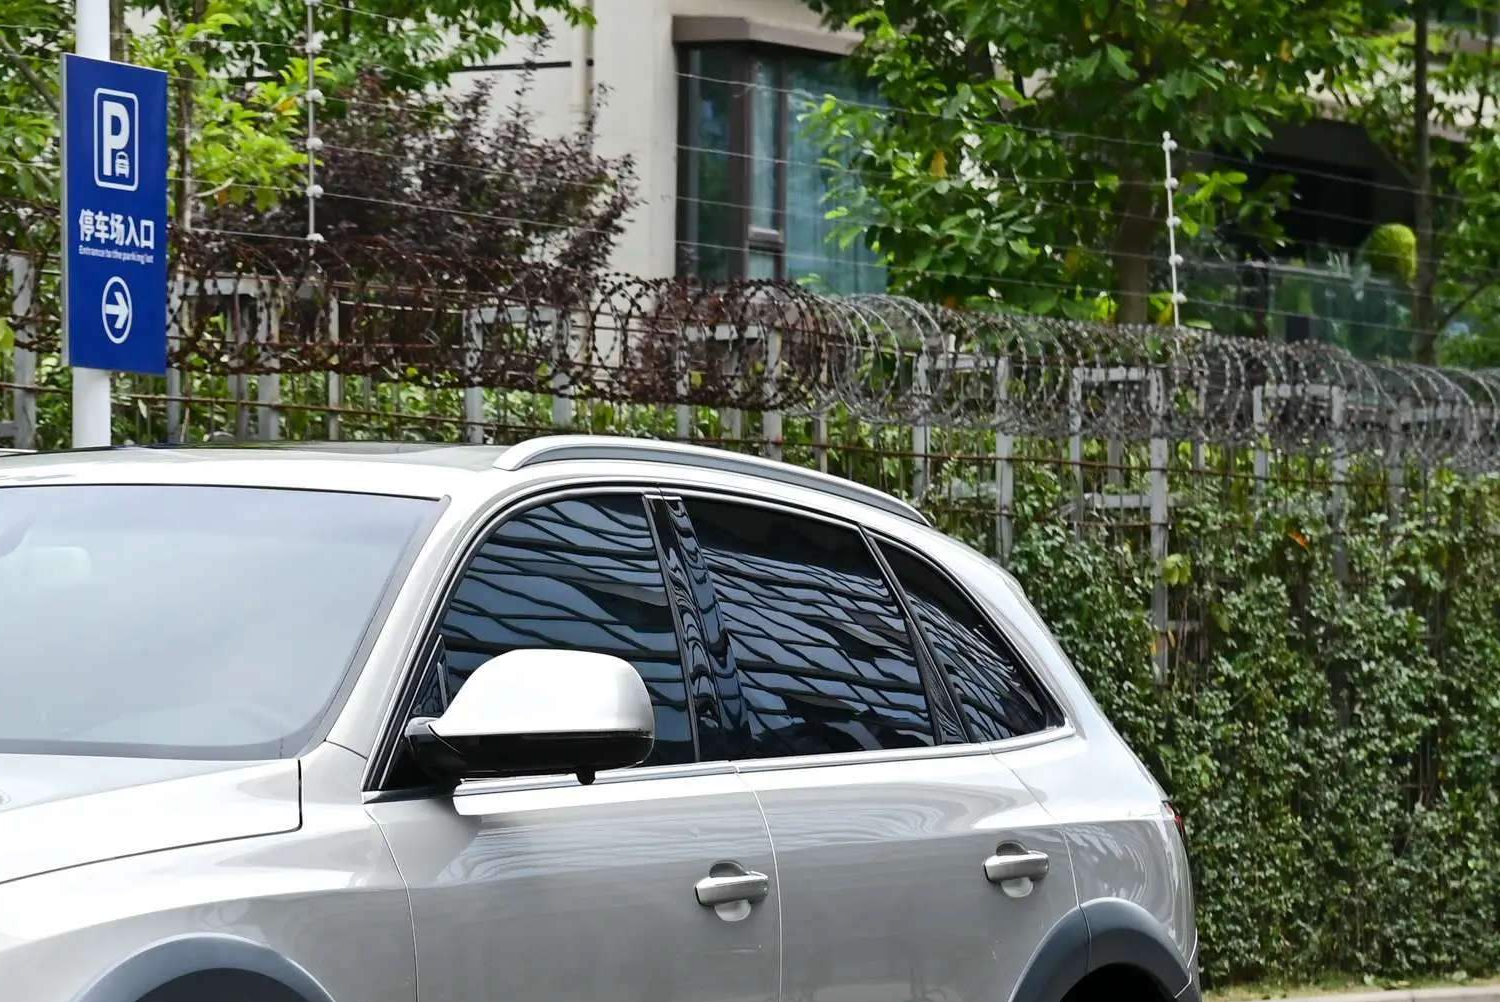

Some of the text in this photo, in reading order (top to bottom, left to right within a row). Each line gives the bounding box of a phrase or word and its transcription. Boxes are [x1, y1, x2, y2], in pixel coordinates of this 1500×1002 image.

[102, 100, 130, 177] P
[79, 208, 155, 250] 停车场入口
